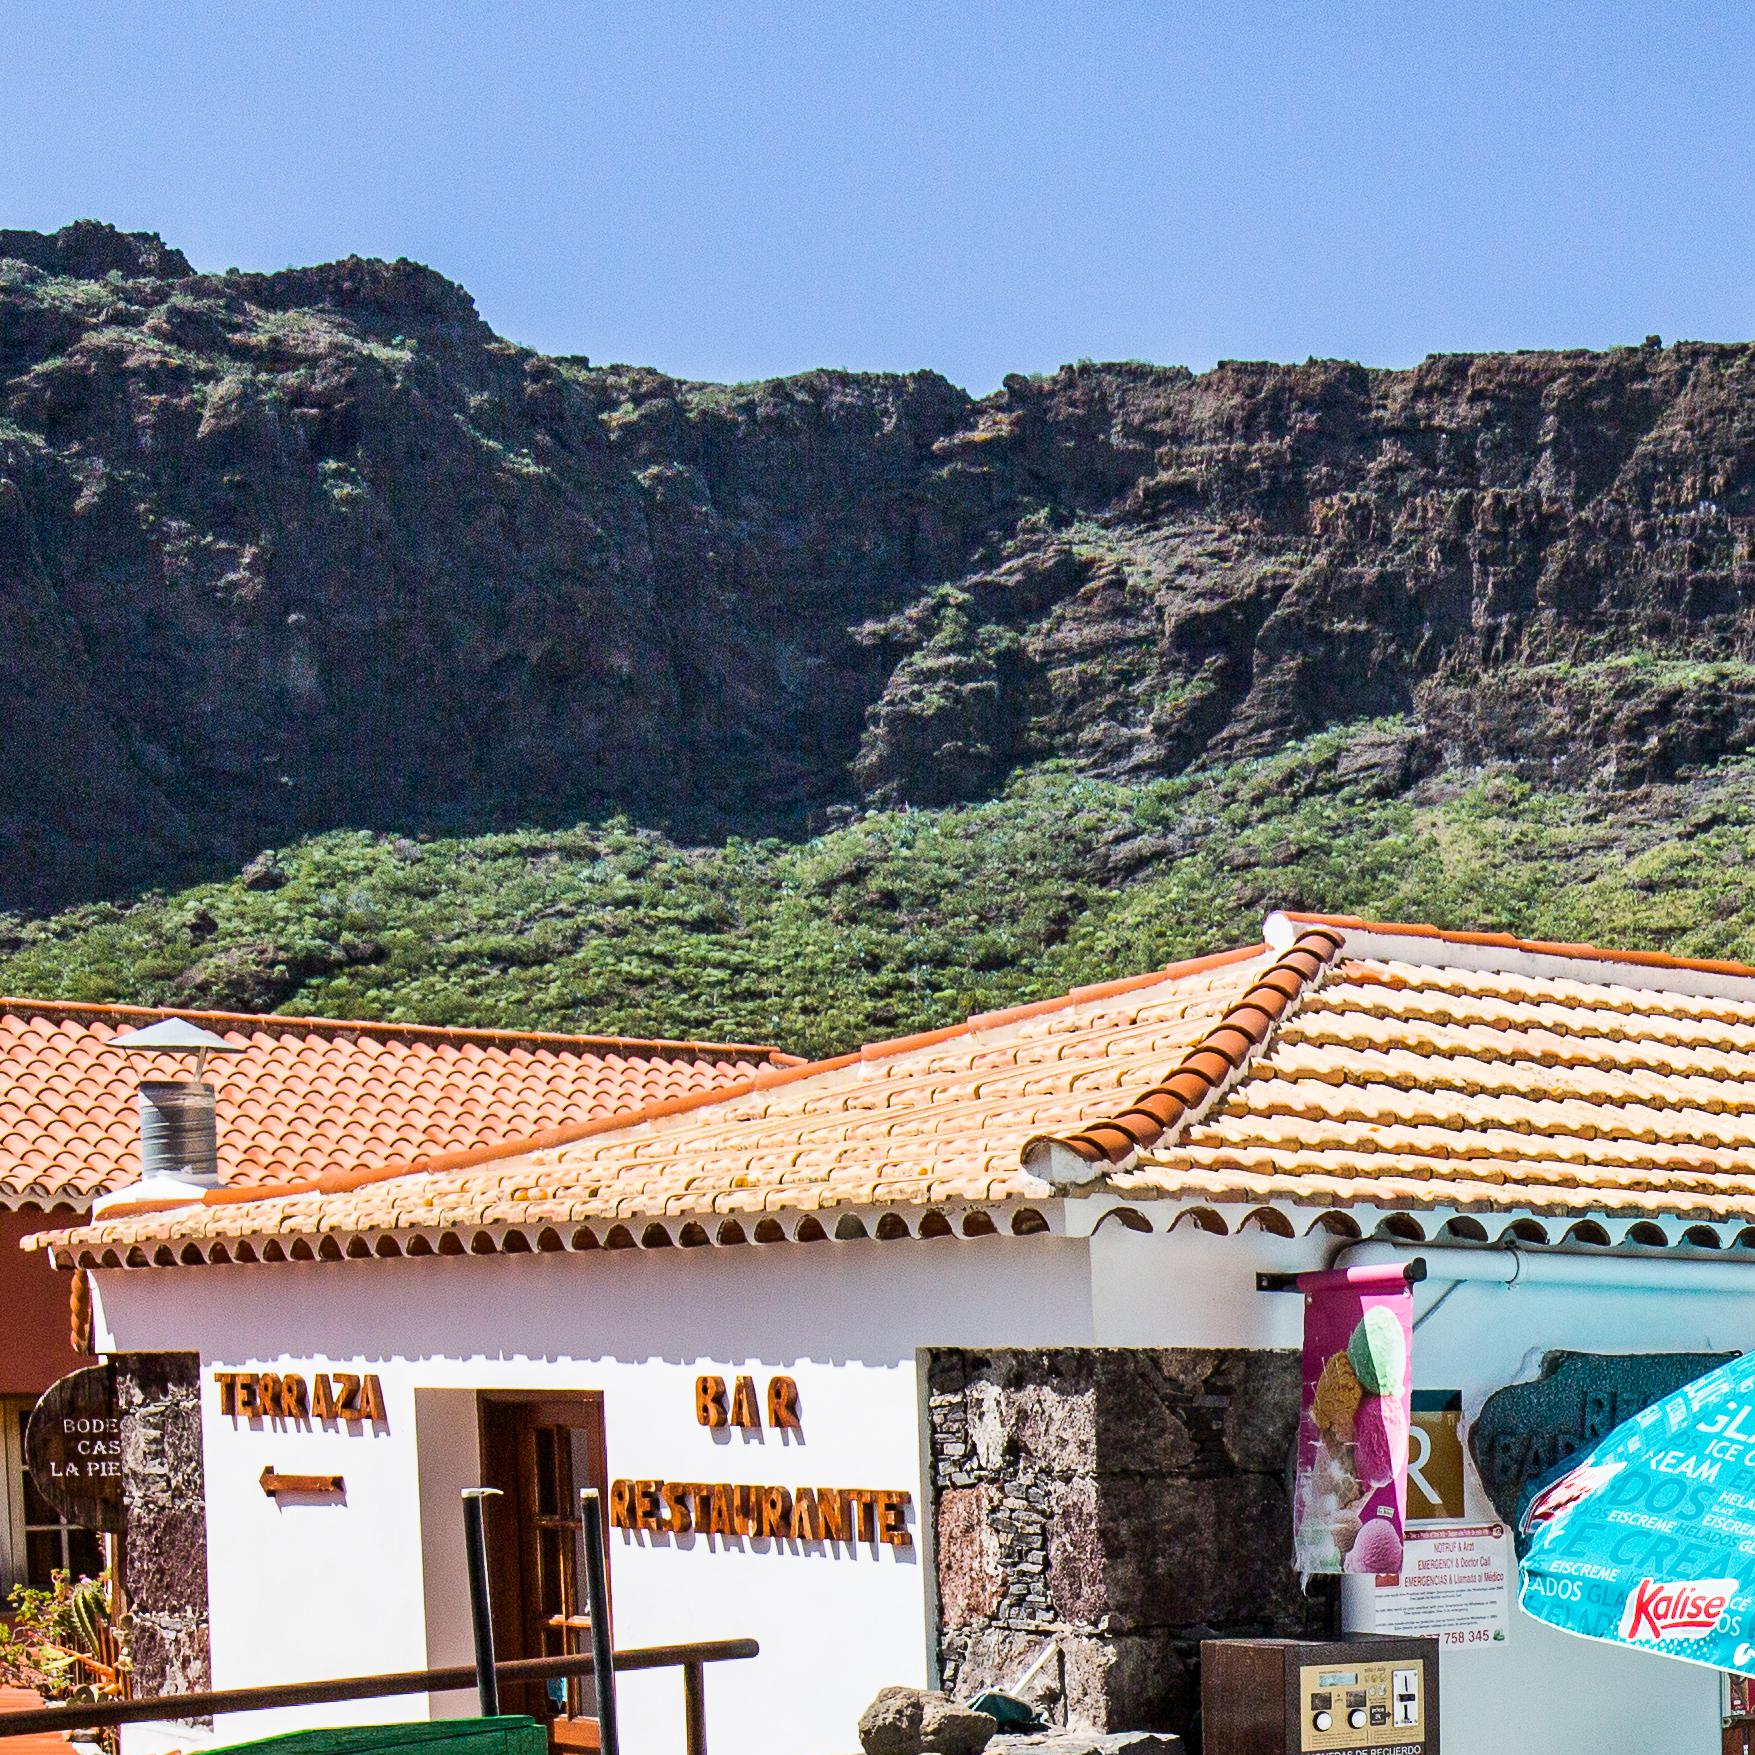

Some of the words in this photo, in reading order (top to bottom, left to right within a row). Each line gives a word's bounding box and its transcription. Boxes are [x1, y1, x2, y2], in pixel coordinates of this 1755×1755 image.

[213, 1372, 380, 1422] TERRAZA
[695, 1375, 803, 1429] BAR
[63, 1418, 120, 1434] BODE
[77, 1440, 121, 1456] CAS
[1704, 1439, 1744, 1462] ICE
[50, 1462, 79, 1477] LA
[87, 1462, 122, 1477] PIE
[610, 1478, 913, 1547] RESTAURANTE
[1607, 1509, 1679, 1534] EISCREME
[1549, 1559, 1621, 1583] EISCREME
[1627, 1578, 1727, 1639] Kalise
[1445, 1631, 1465, 1644] 758
[1467, 1629, 1490, 1643] 345
